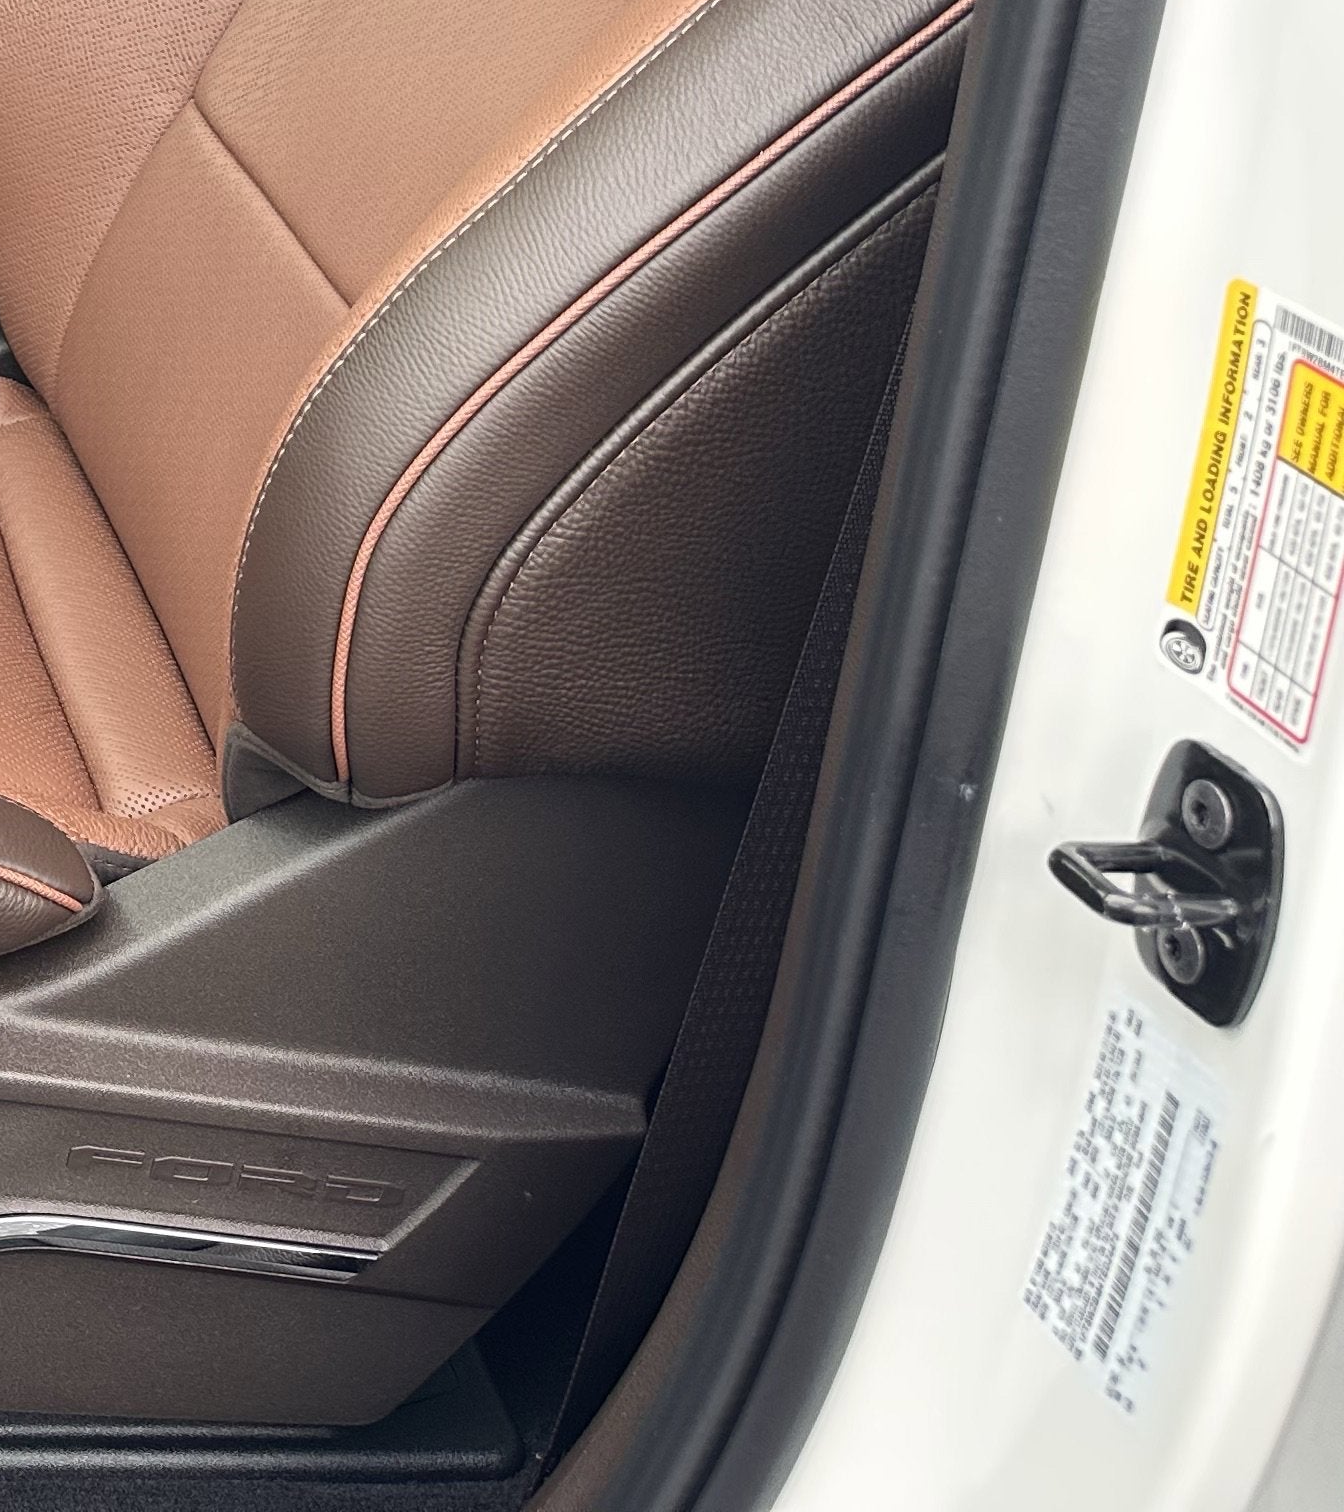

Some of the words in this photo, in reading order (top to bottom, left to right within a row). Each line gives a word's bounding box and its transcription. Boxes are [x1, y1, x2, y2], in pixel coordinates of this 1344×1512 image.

[1218, 291, 1252, 426] INFORMATION
[1265, 378, 1281, 416] 3106
[1296, 381, 1313, 436] OWNERS
[1257, 439, 1272, 458] kg
[1263, 420, 1273, 437] or
[1307, 422, 1326, 474] MANUAL
[1318, 390, 1332, 418] FOR
[1292, 439, 1303, 463] SEE
[1199, 430, 1228, 515] LOADING
[1250, 459, 1266, 497] 1408
[1191, 518, 1208, 559] AND
[1180, 560, 1200, 604] TIRE
[64, 1144, 406, 1209] FORD
